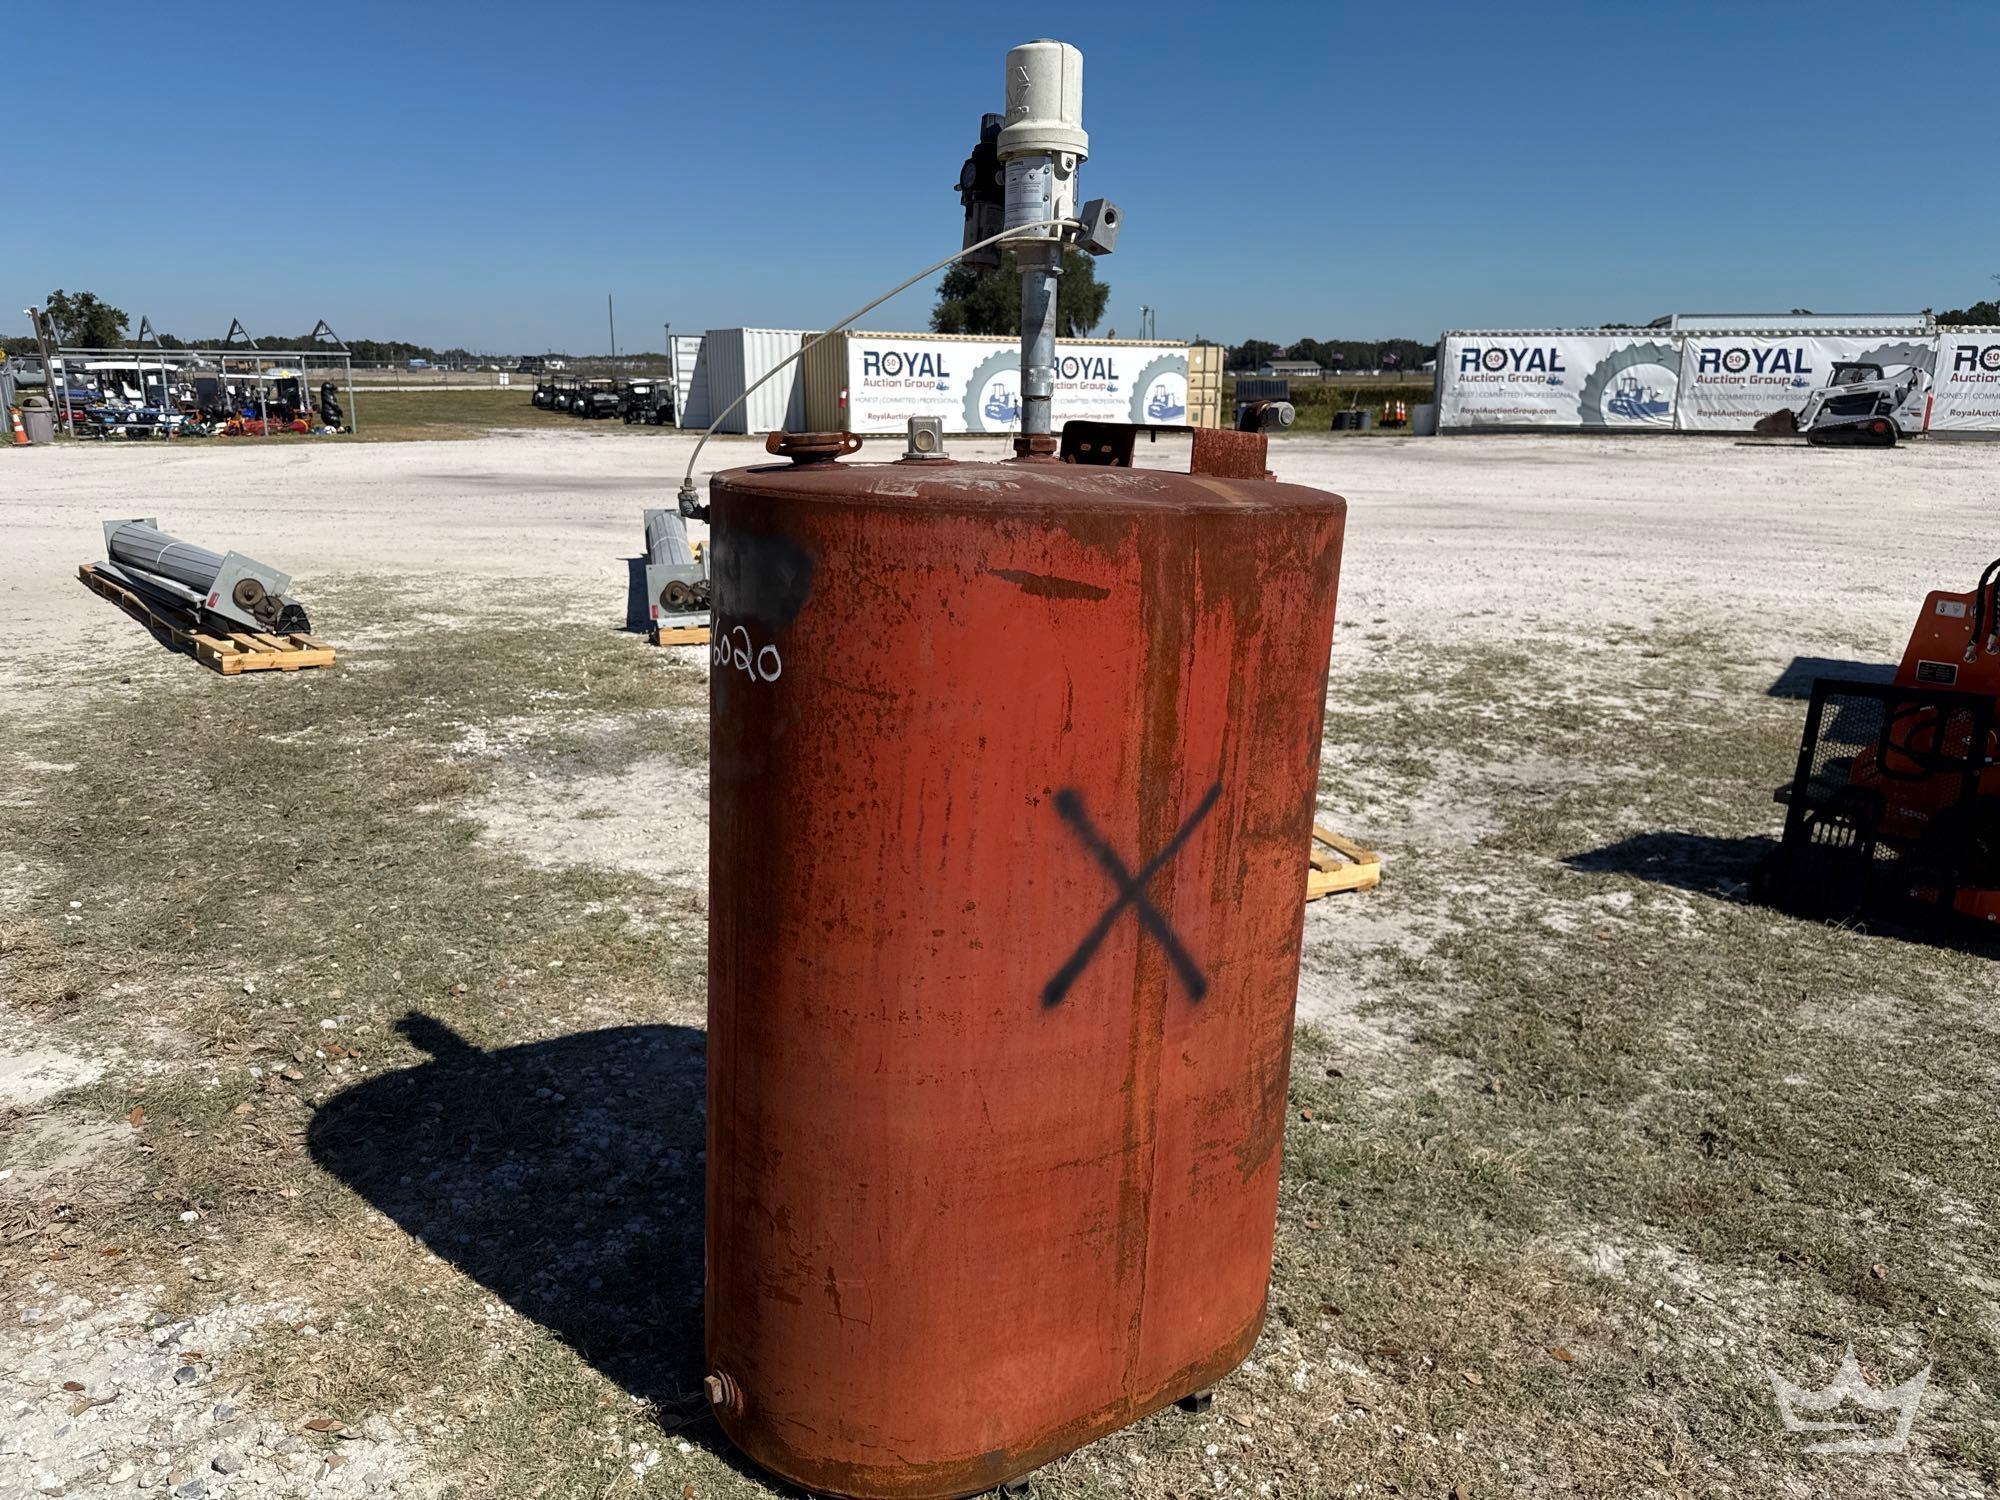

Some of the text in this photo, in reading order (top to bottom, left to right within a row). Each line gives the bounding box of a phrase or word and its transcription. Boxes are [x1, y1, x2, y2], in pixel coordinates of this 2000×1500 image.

[863, 350, 950, 378] ROYAL
[1460, 347, 1566, 373] ROYAL
[1698, 348, 1813, 374] ROYAL
[863, 377, 936, 390] Auction Group
[1458, 373, 1547, 385] Auction Group
[1696, 374, 1791, 387] Auction Group
[1079, 381, 1107, 392] Group
[1717, 393, 1762, 401] COMMITTED
[1936, 392, 1969, 400] HONEST
[1460, 407, 1557, 416] RoyalAuctionGroup.com
[713, 618, 782, 682] 6020
